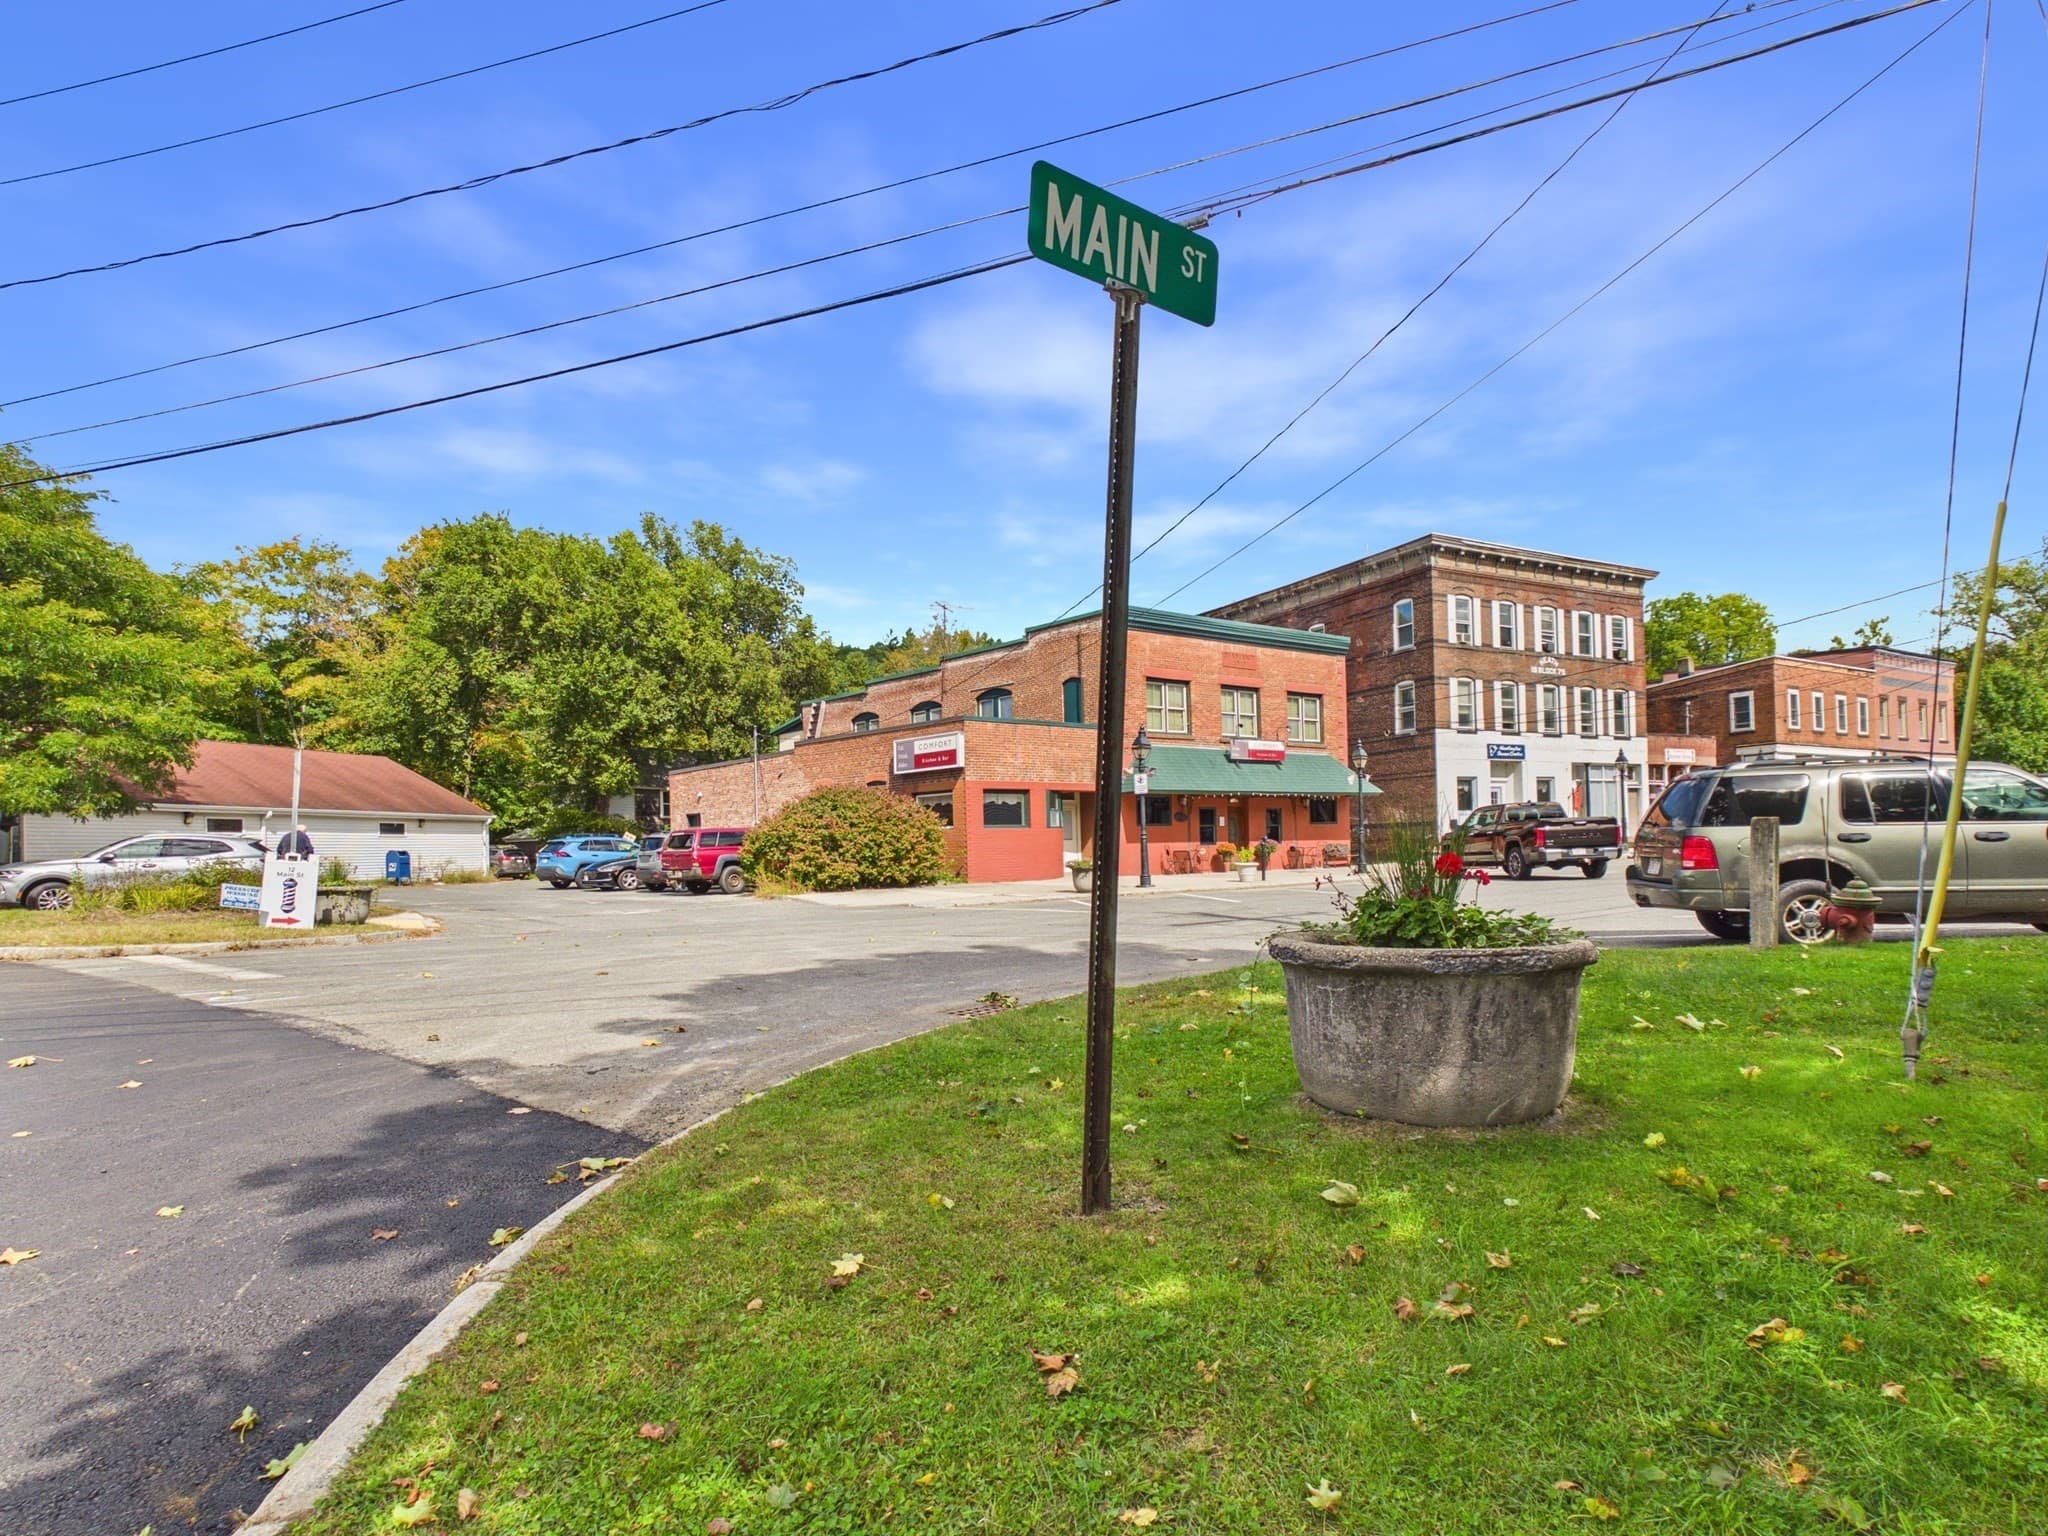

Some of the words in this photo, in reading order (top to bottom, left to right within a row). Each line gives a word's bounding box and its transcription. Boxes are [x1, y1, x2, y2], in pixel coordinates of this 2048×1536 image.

[1045, 181, 1160, 293] MAIN
[1181, 245, 1207, 283] ST
[918, 739, 952, 751] COMFORT
